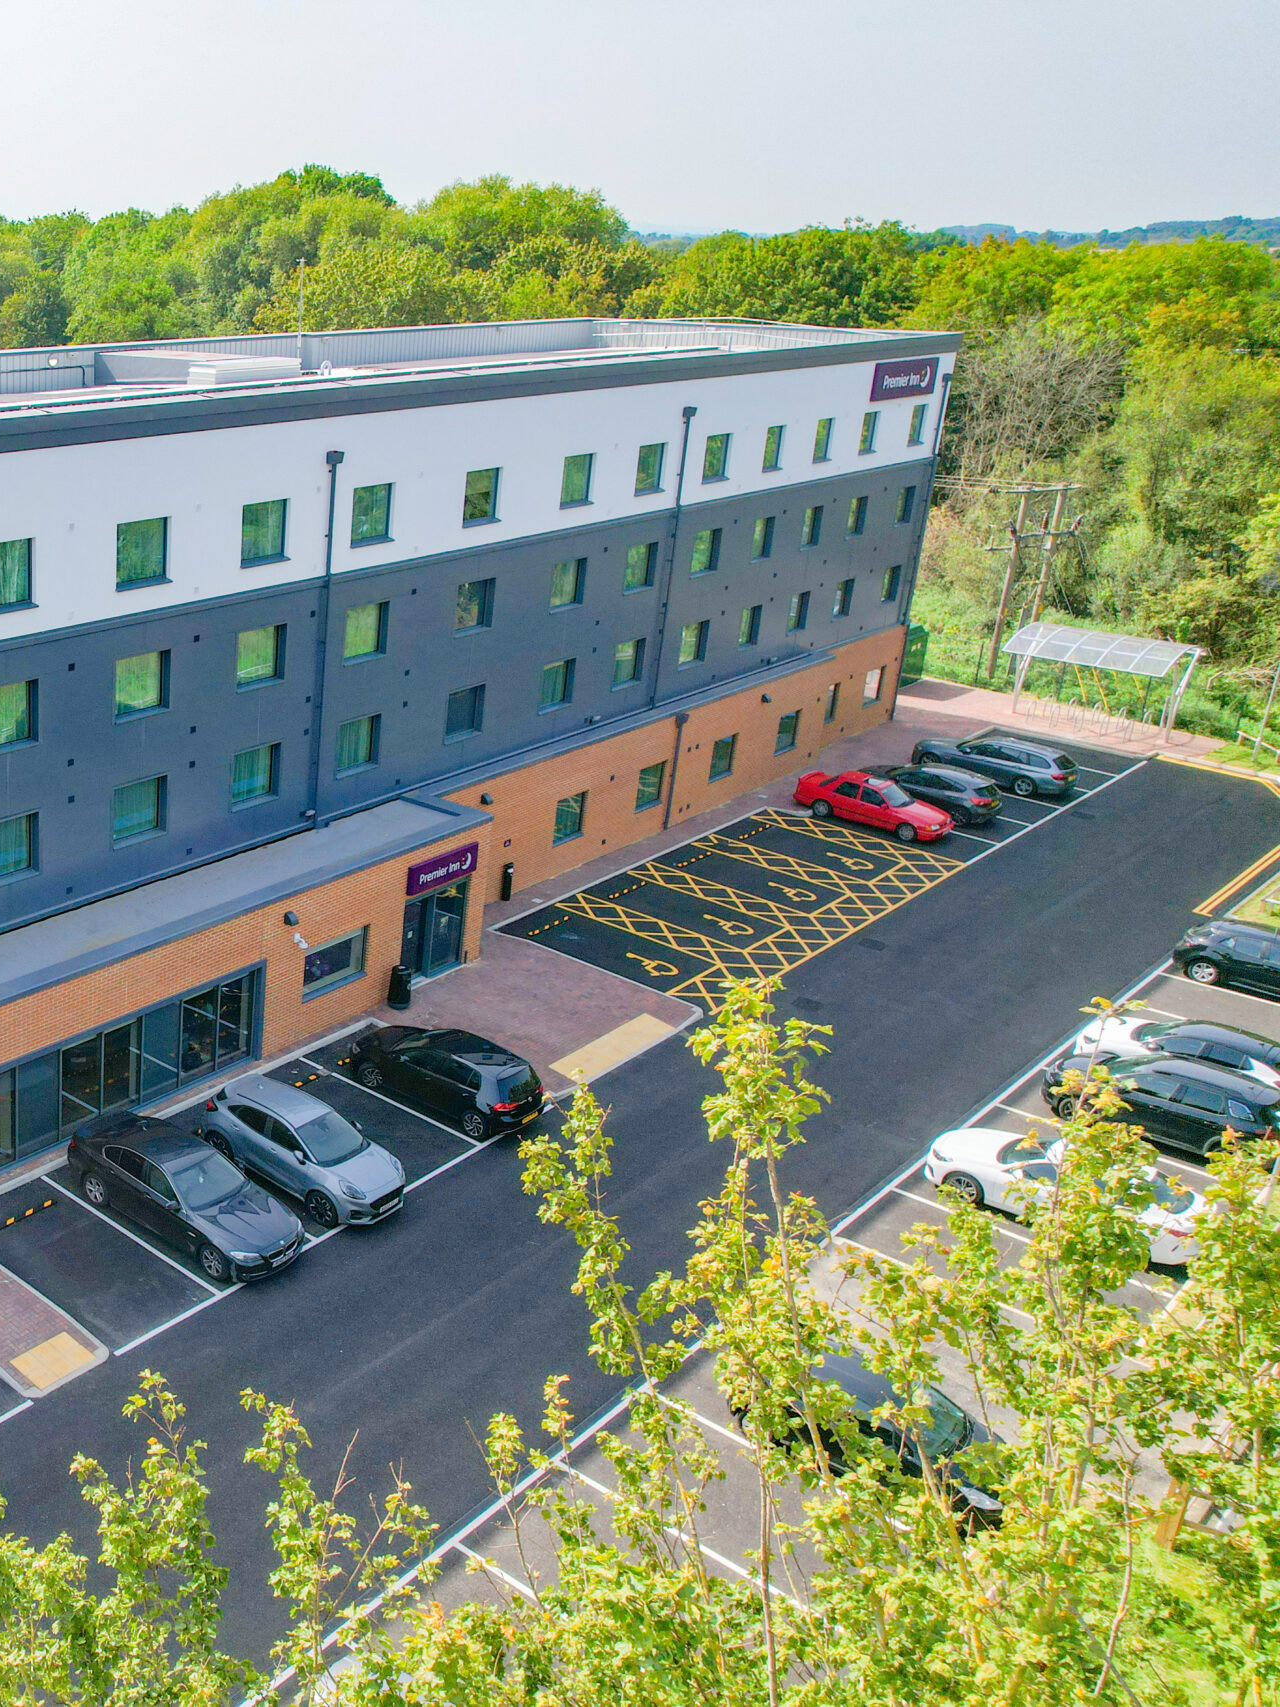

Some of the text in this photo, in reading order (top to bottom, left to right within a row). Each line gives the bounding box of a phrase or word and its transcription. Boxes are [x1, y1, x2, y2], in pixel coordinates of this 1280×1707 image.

[882, 372, 920, 390] Premier Inn
[419, 861, 460, 885] Premier Inn
